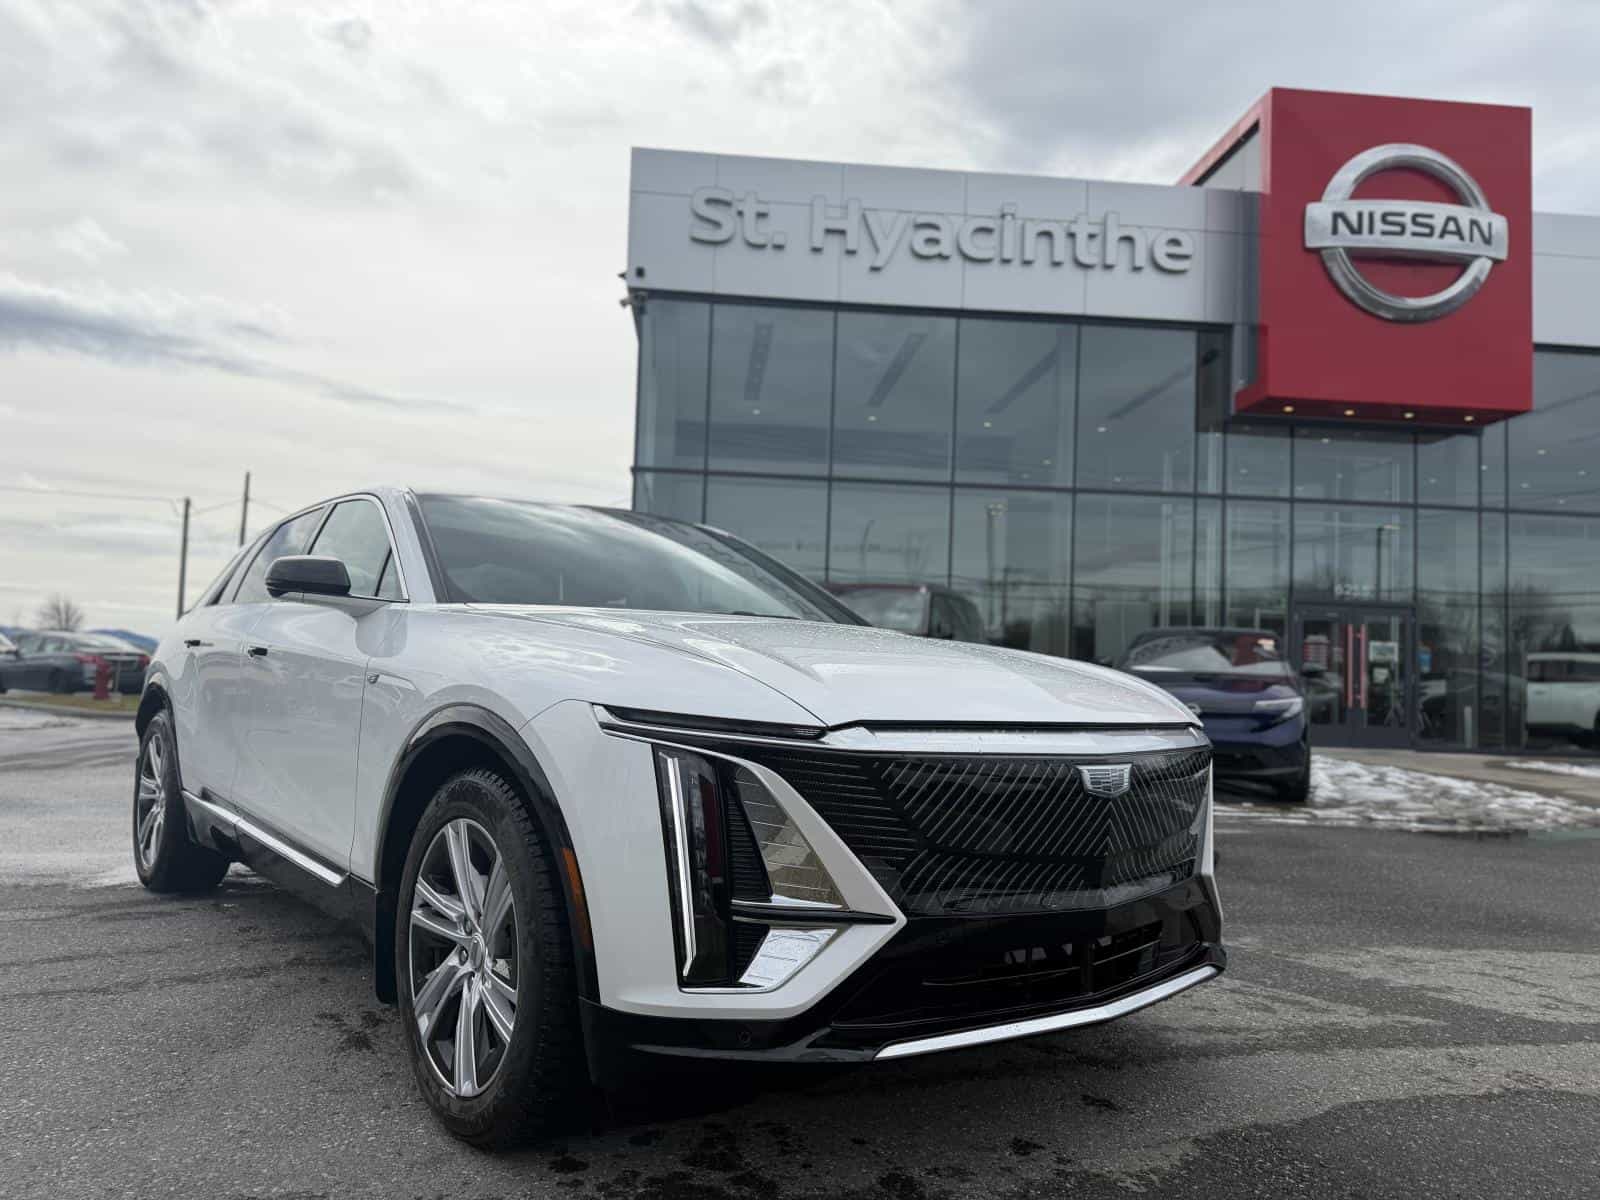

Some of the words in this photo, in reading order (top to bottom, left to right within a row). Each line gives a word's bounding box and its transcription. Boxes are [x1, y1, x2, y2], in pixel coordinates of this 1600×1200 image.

[690, 186, 786, 249] St.
[811, 195, 1194, 275] Hyacinthe
[1331, 210, 1493, 246] NISSAN
